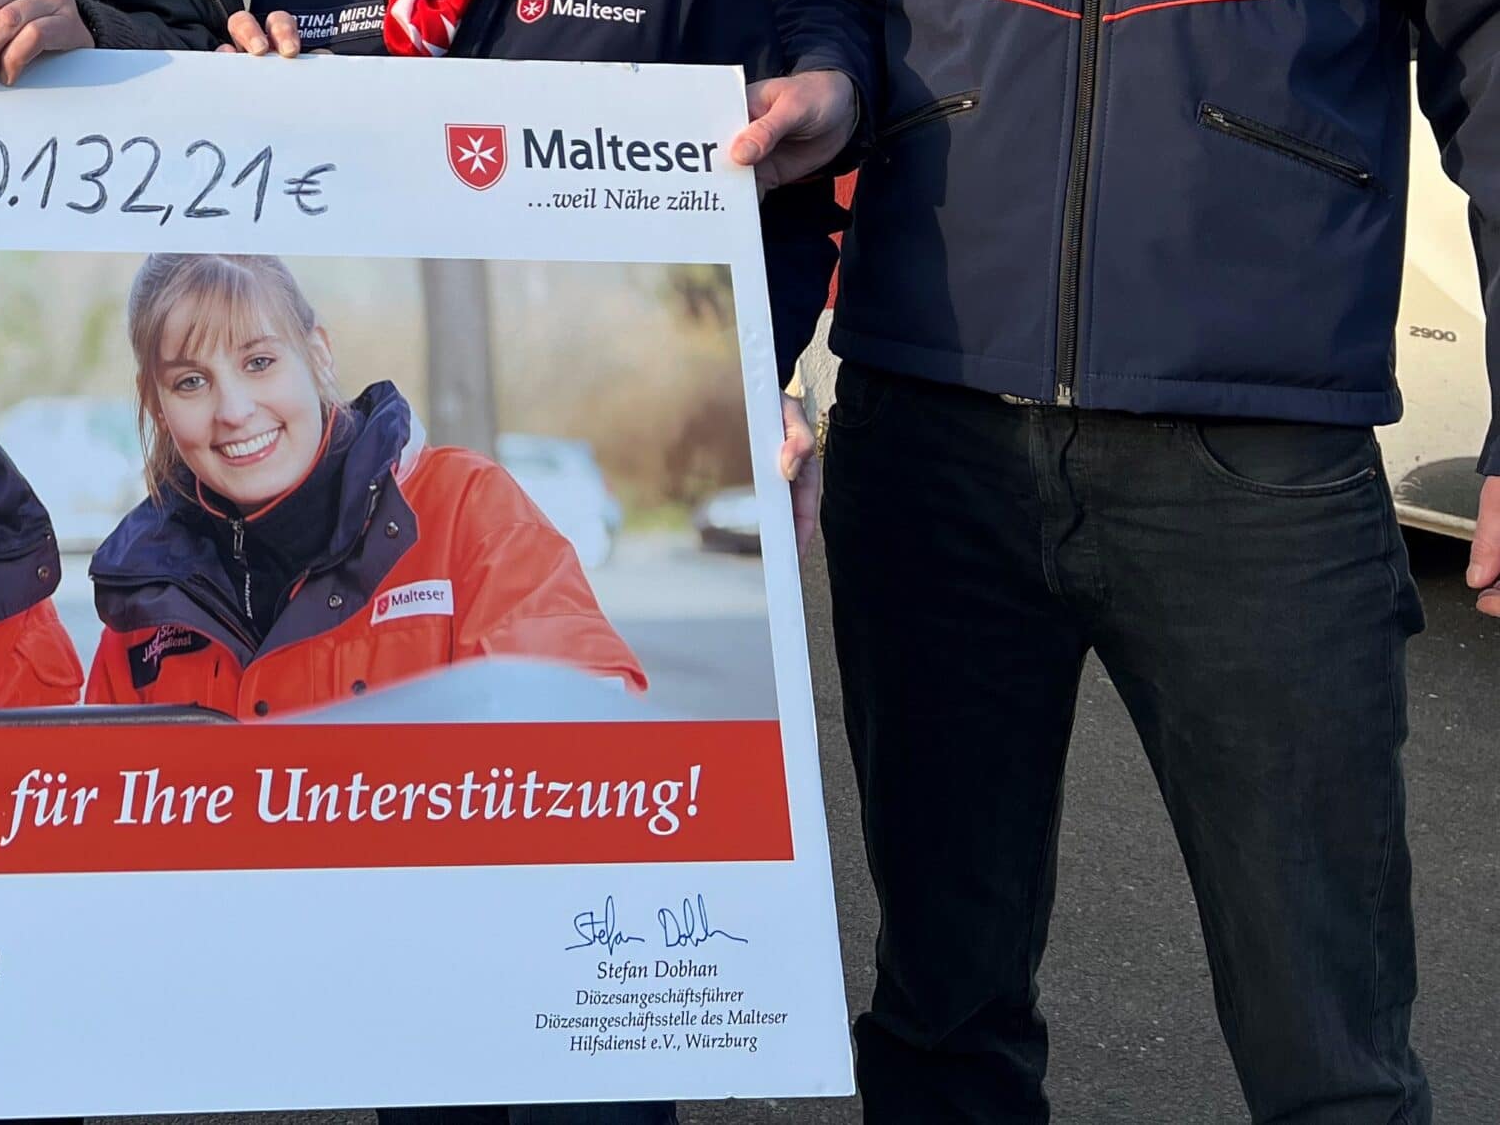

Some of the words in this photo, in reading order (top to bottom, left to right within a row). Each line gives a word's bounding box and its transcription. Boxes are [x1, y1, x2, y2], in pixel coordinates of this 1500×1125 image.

[292, 13, 334, 27] TINA
[523, 127, 718, 173] Malteser
[603, 188, 660, 211] Nähe
[667, 190, 726, 212] zählt.
[1409, 325, 1457, 343] 2900
[391, 590, 445, 607] Malteser
[0, 768, 100, 845] für
[114, 768, 235, 826] Ihre
[255, 764, 702, 836] Unterstützung!
[597, 960, 648, 984] Stefan
[654, 959, 719, 979] Dobhan
[575, 987, 744, 1009] Diözesangeschäftsführer
[535, 1010, 698, 1033] Diözesangeschäftsstelle
[701, 1012, 724, 1026] des
[727, 1010, 789, 1026] Malteser
[570, 1033, 647, 1056] Hilfsdienst
[650, 1034, 682, 1052] e.V.,
[685, 1033, 759, 1053] Würzburg
